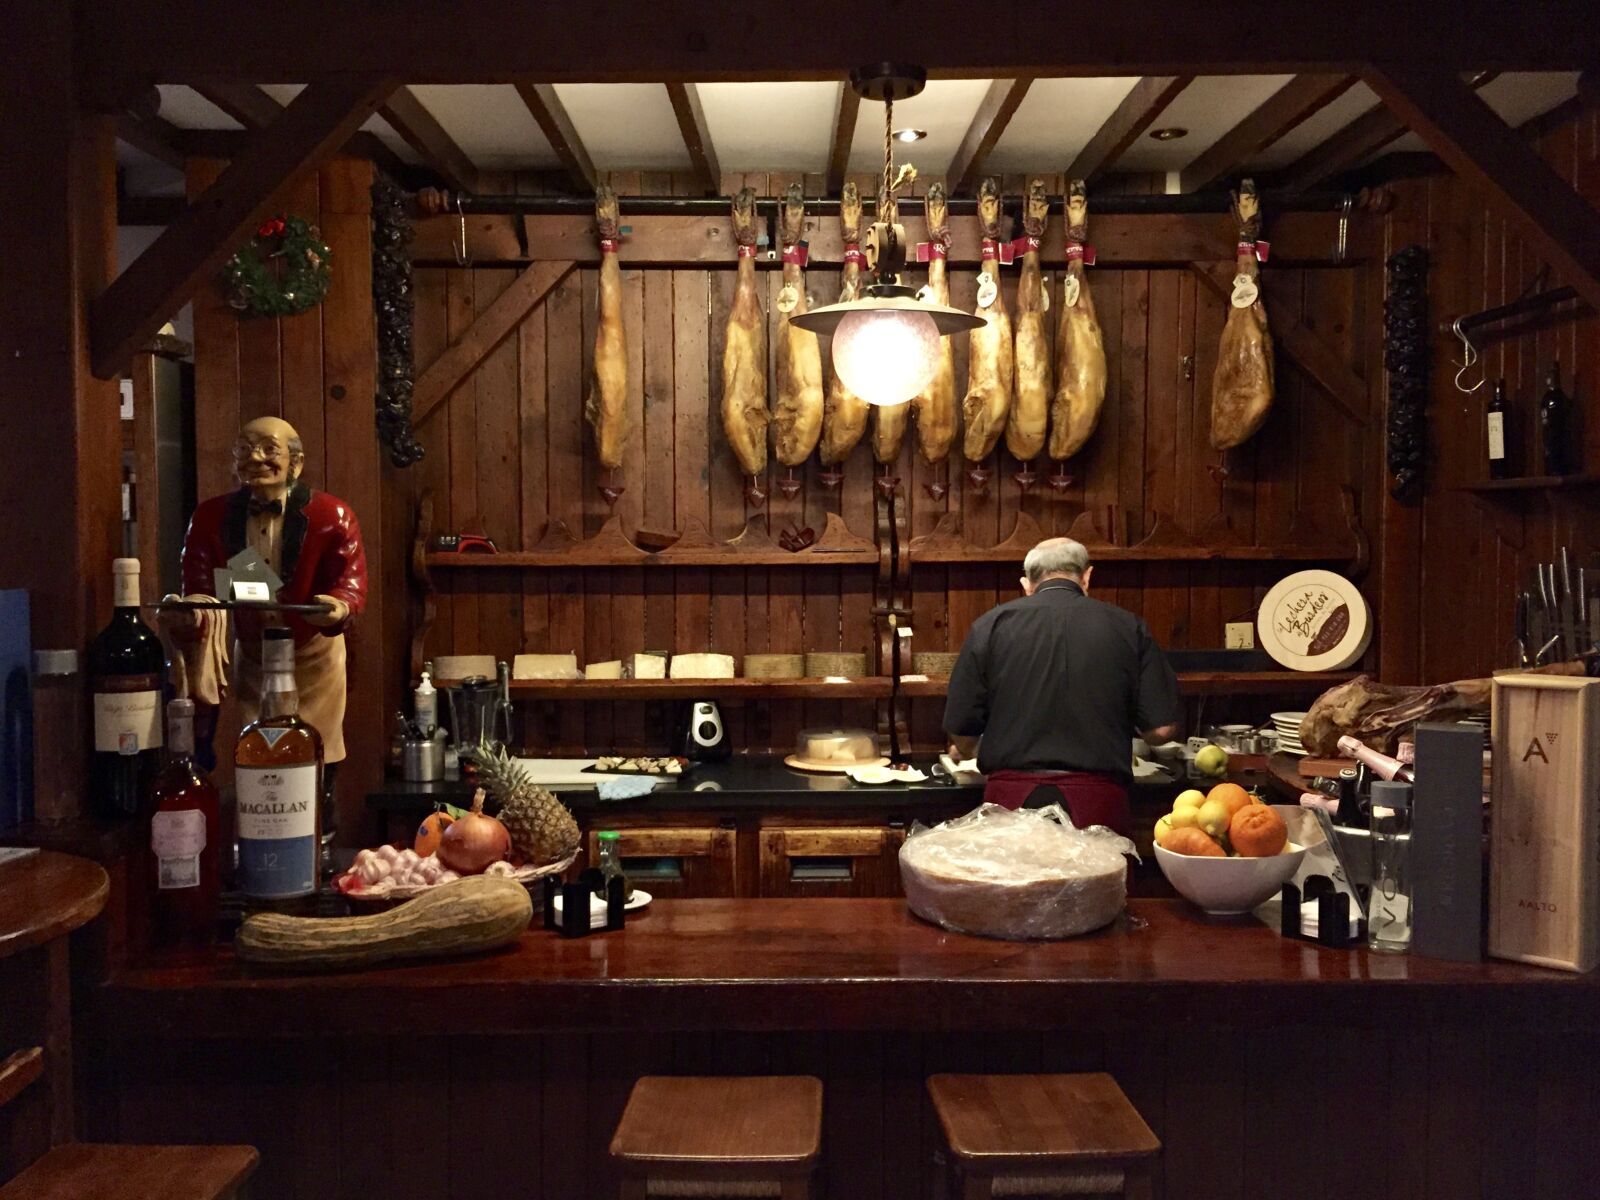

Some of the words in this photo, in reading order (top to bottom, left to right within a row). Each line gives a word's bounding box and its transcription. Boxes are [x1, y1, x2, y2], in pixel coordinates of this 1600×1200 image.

[1292, 593, 1329, 638] Burdeos
[1522, 737, 1549, 764] A
[239, 800, 309, 815] MACALLAN
[263, 853, 278, 868] 12
[1518, 900, 1557, 913] AALTO
